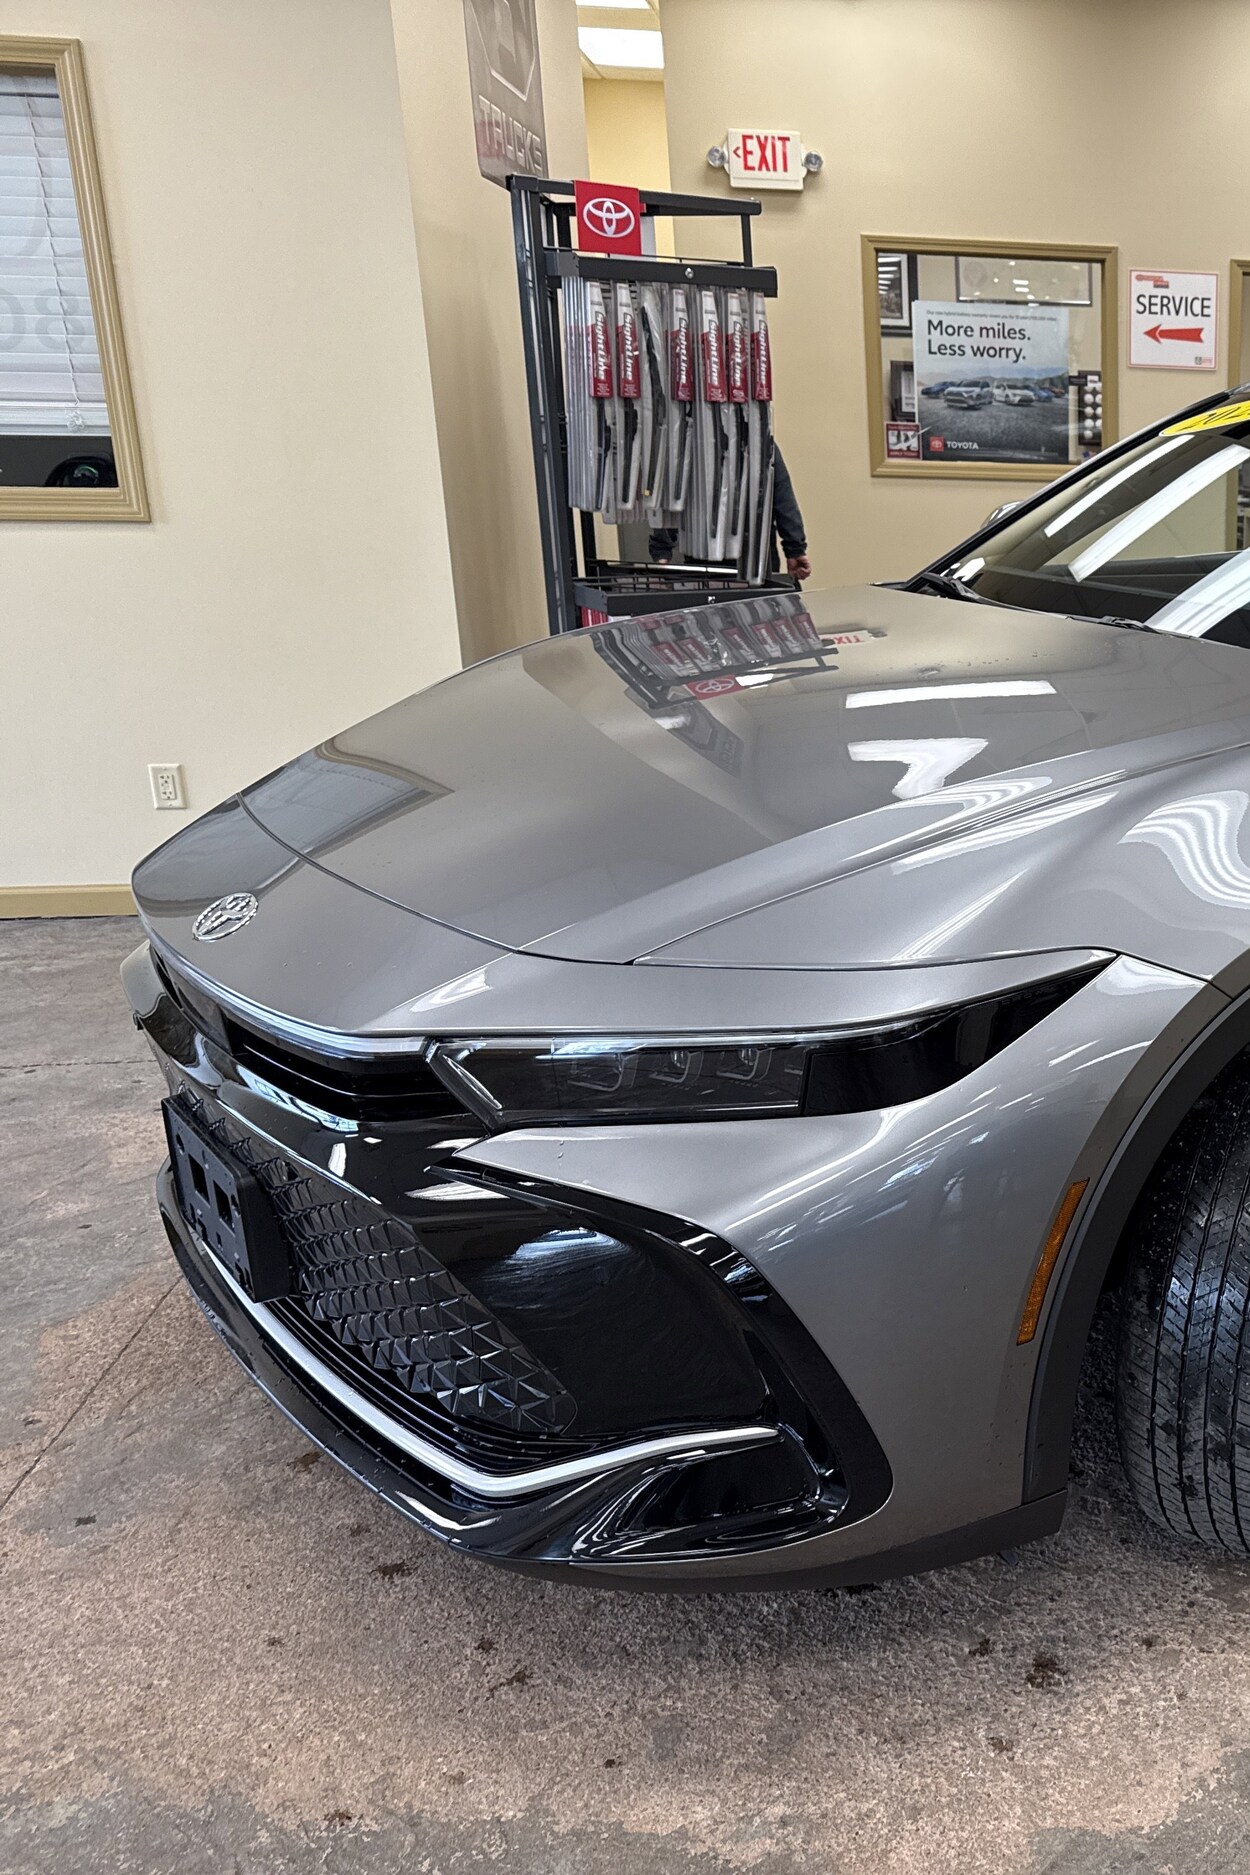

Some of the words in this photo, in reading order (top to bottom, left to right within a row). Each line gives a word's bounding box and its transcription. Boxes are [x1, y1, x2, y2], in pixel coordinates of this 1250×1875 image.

[478, 94, 543, 175] TRUCKS
[741, 134, 791, 172] EXIT
[1136, 294, 1211, 317] SERVICE
[928, 320, 974, 337] More
[980, 323, 1031, 341] miles.
[928, 339, 966, 357] Less
[971, 344, 1026, 363] worry.
[946, 441, 979, 450] TOYOTA
